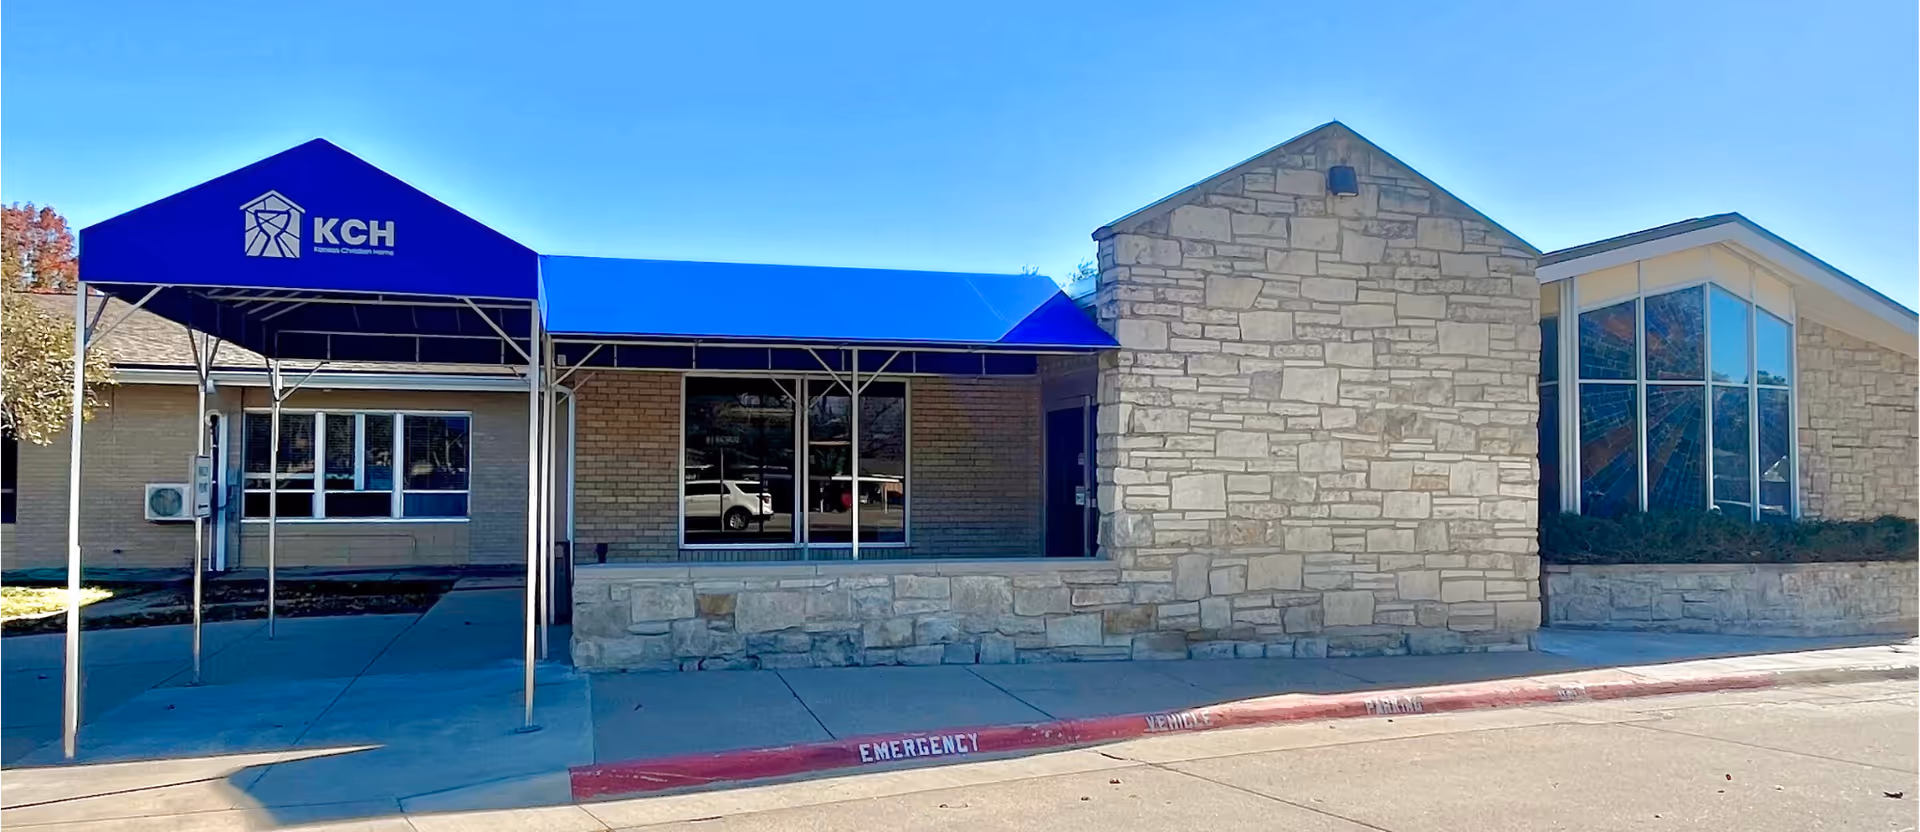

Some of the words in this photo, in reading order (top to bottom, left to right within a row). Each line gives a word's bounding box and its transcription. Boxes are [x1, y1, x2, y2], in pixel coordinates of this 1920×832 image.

[313, 217, 395, 247] KCH
[859, 732, 979, 763] EMERGENCY
[1144, 710, 1211, 732] VEHICLE
